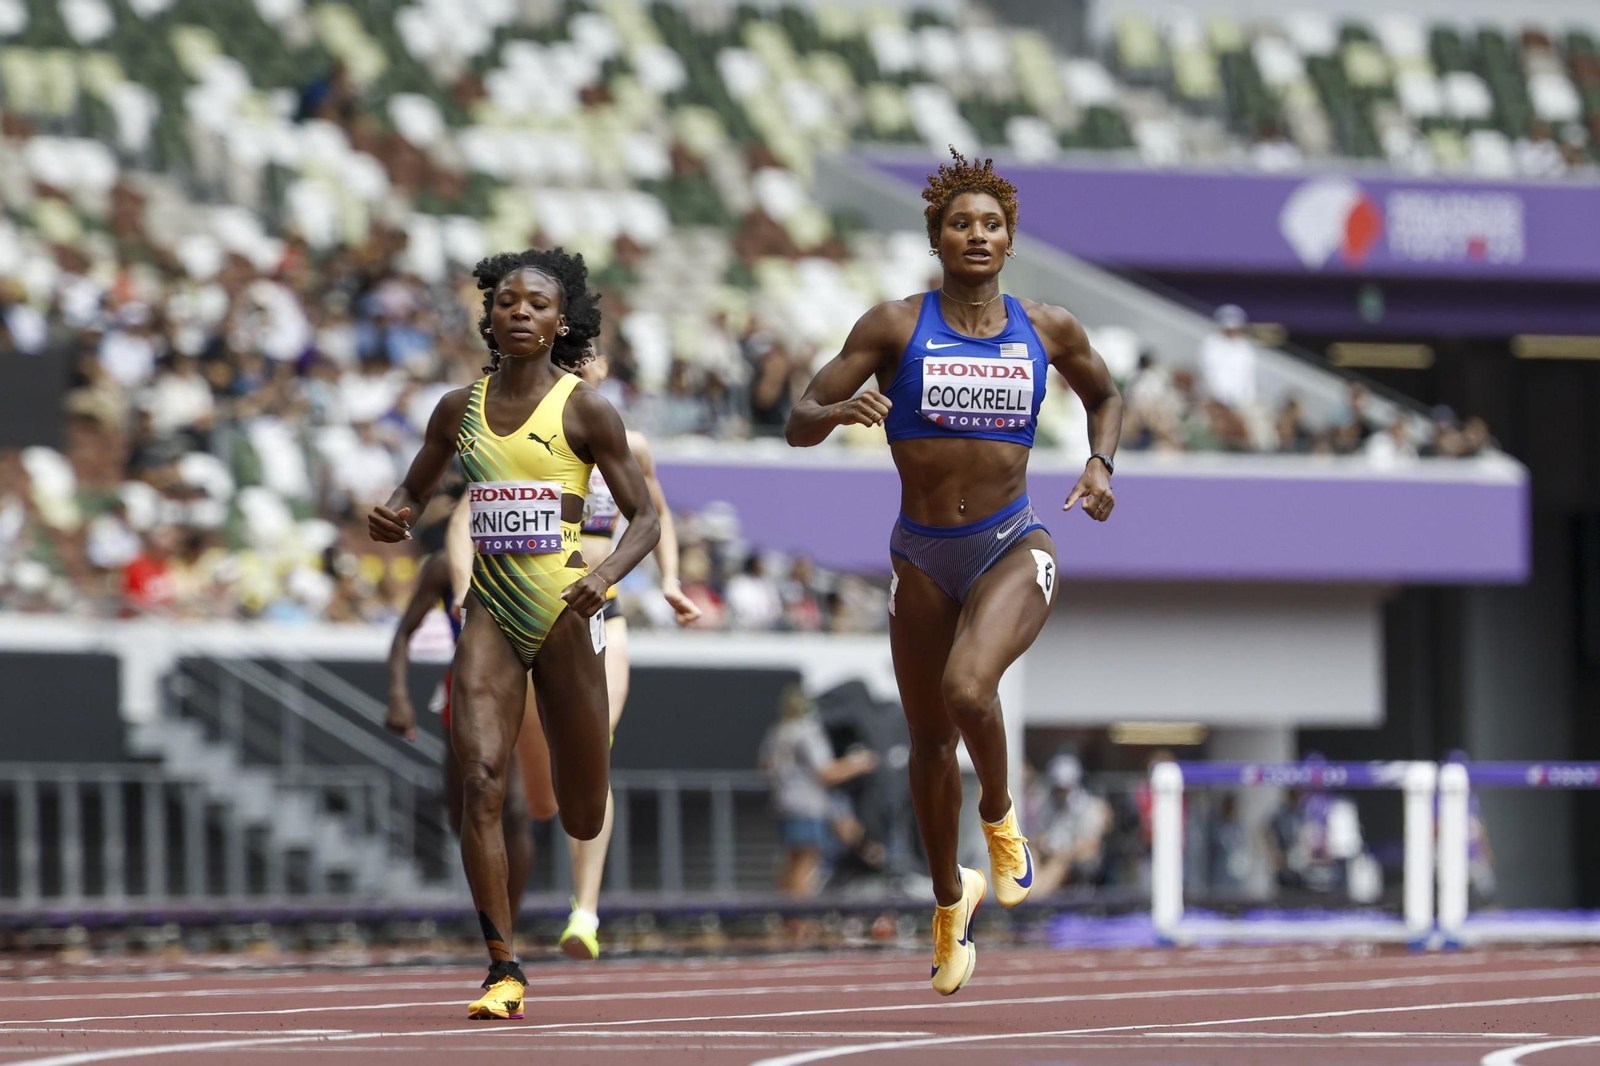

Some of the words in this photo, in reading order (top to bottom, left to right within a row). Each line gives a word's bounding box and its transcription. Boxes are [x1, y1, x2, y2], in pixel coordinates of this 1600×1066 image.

[925, 363, 1031, 380] HONDA
[927, 385, 1027, 411] COCKRELL
[469, 487, 559, 502] HONDA
[472, 510, 555, 533] KNIGHT
[1045, 562, 1053, 592] 6
